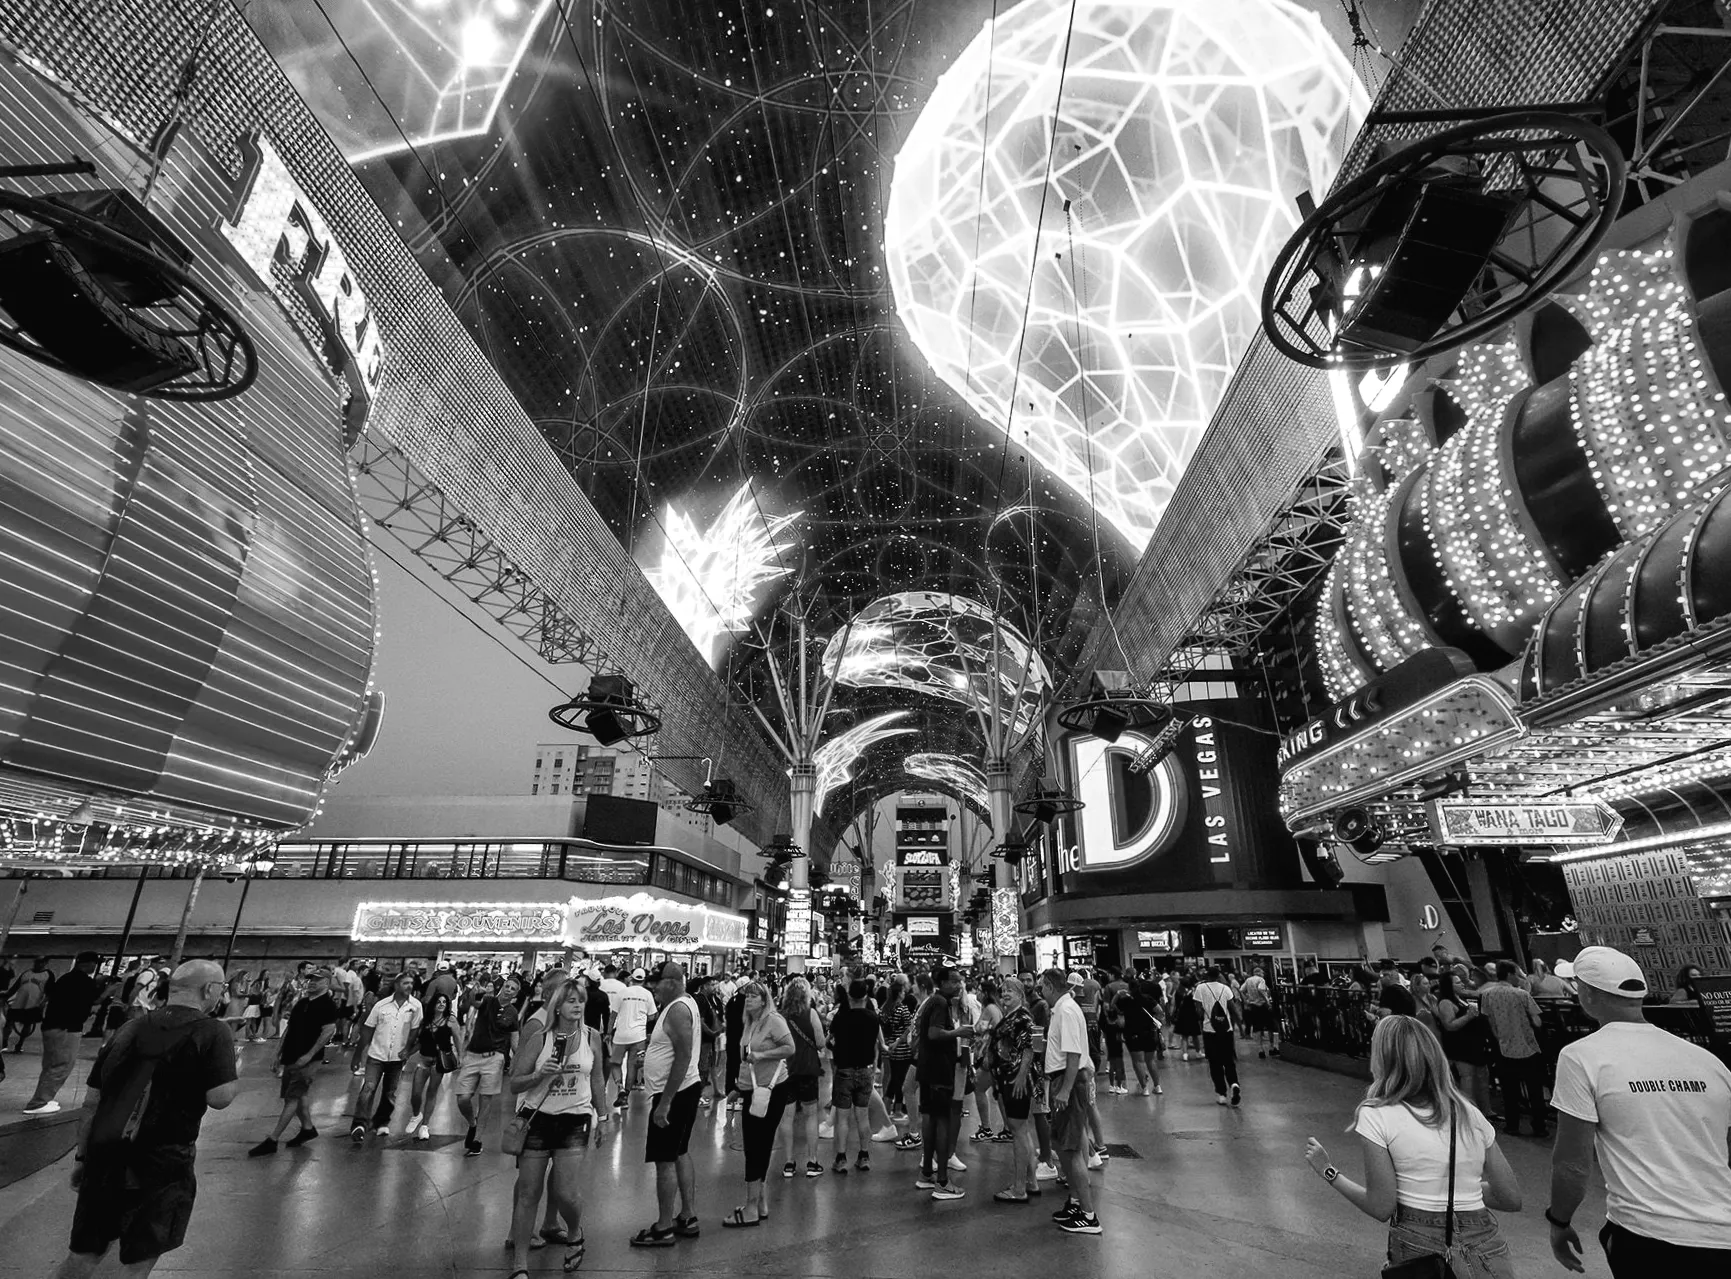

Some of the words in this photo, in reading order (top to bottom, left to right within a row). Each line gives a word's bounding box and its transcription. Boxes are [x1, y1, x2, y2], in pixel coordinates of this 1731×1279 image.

[1192, 717, 1221, 799] VEGAS
[1069, 731, 1178, 873] D
[1474, 809, 1520, 829] WANA
[1523, 808, 1569, 828] TACO
[1519, 827, 1544, 835] more
[1204, 815, 1230, 863] LAS
[366, 915, 424, 930] GIFTS
[426, 915, 443, 930] &
[444, 914, 556, 931] SOUVENIRS
[580, 911, 626, 934] Las
[631, 913, 691, 943] Vegas
[1628, 1079, 1667, 1093] DOUBLE
[1668, 1079, 1707, 1093] CHAMP
